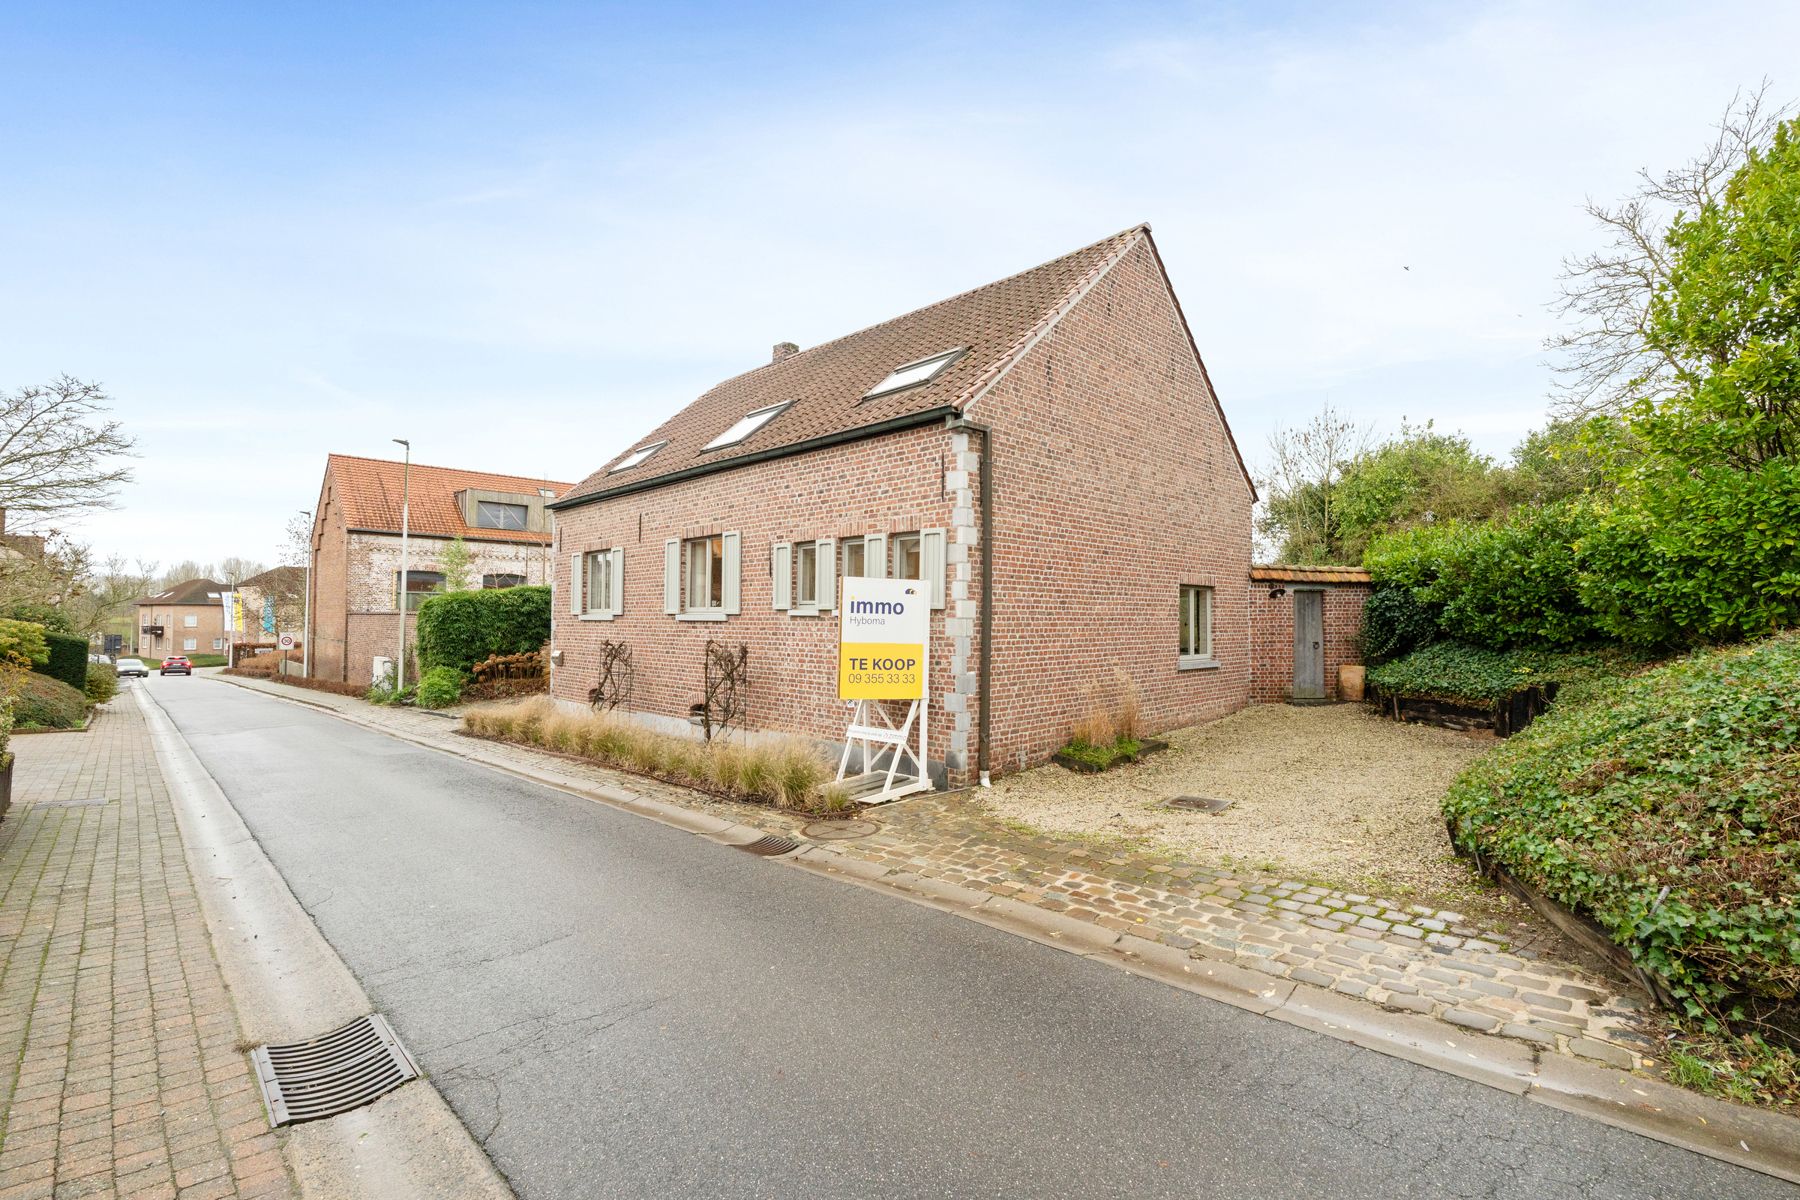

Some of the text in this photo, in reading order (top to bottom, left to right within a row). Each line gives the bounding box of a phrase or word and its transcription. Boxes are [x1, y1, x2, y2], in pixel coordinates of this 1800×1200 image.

[850, 595, 904, 615] immo
[849, 616, 886, 627] Hyboma
[849, 658, 916, 671] TE KOOP
[848, 673, 916, 684] 09 355 33 33
